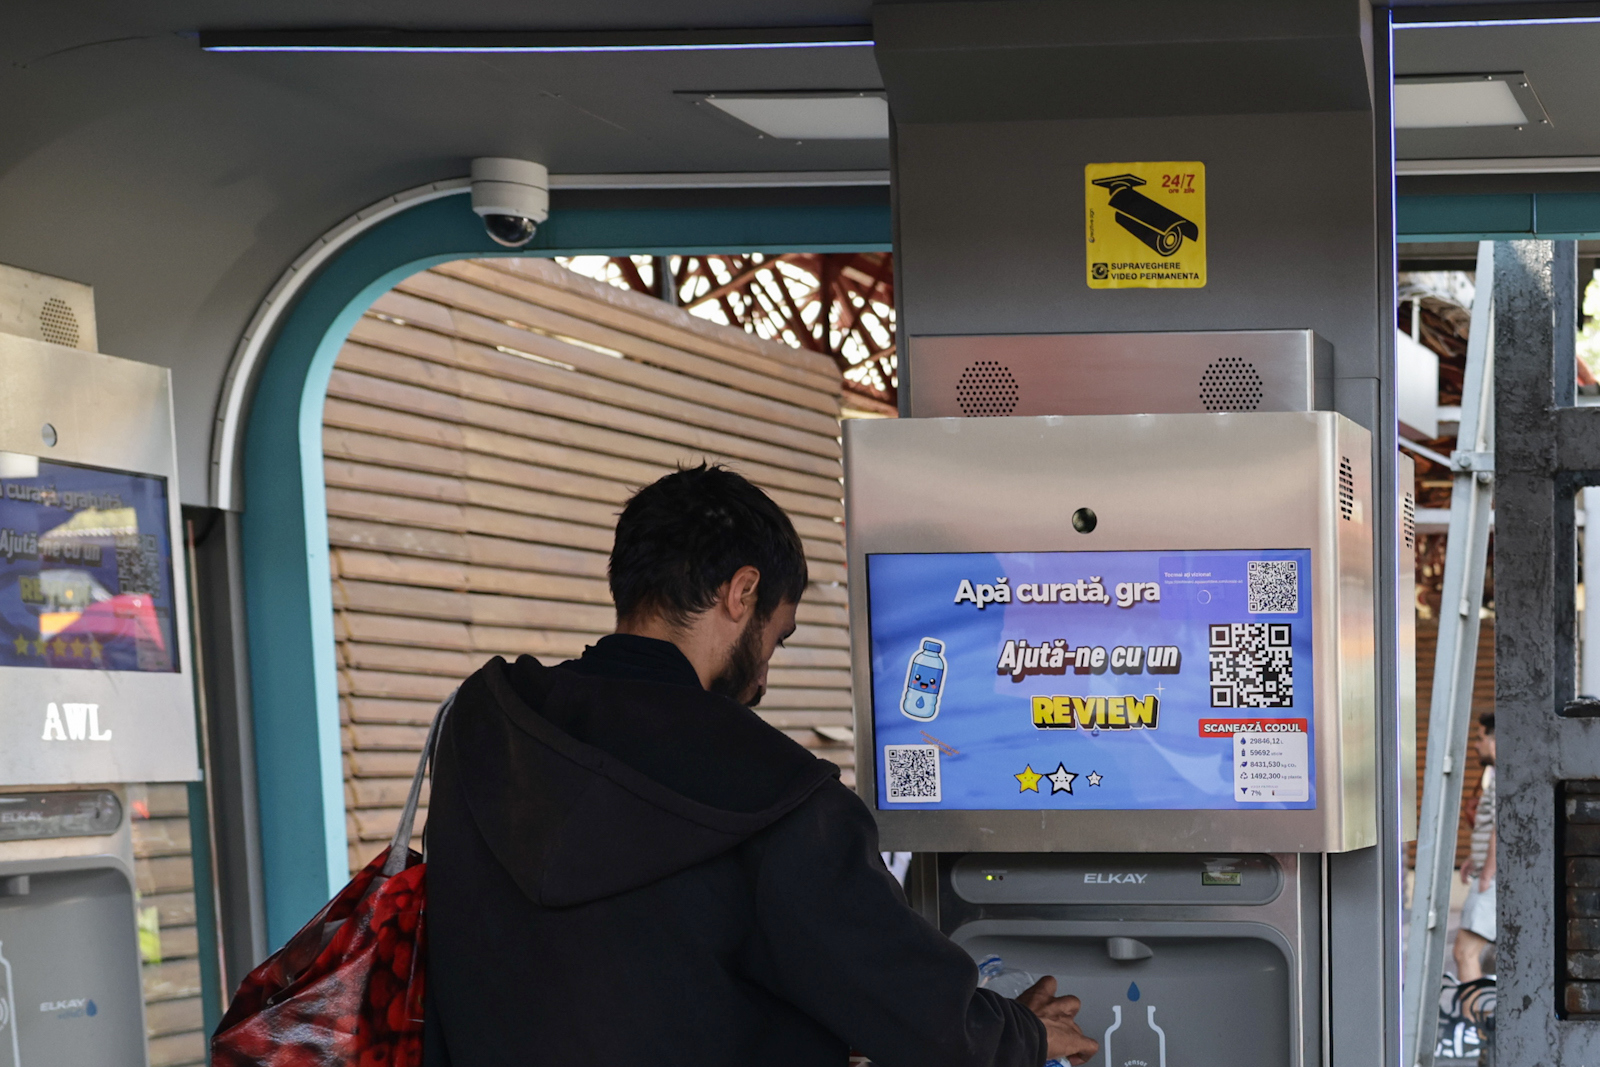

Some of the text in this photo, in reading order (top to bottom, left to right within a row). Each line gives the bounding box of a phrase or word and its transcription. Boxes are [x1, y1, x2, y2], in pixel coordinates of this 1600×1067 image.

[1161, 173, 1196, 189] 24/7
[1111, 262, 1181, 270] SUPRAVEGHERE
[1140, 272, 1200, 280] PERMANENTA
[954, 576, 1160, 608] Apă curată, gra
[998, 639, 1179, 676] Ajută-ne cu un
[1031, 695, 1157, 727] REVIEW
[41, 702, 112, 741] AWL
[1203, 721, 1301, 733] SCANEAZĂ CODUL
[1083, 873, 1148, 884] ELKAY
[40, 998, 86, 1012] ELKAY
